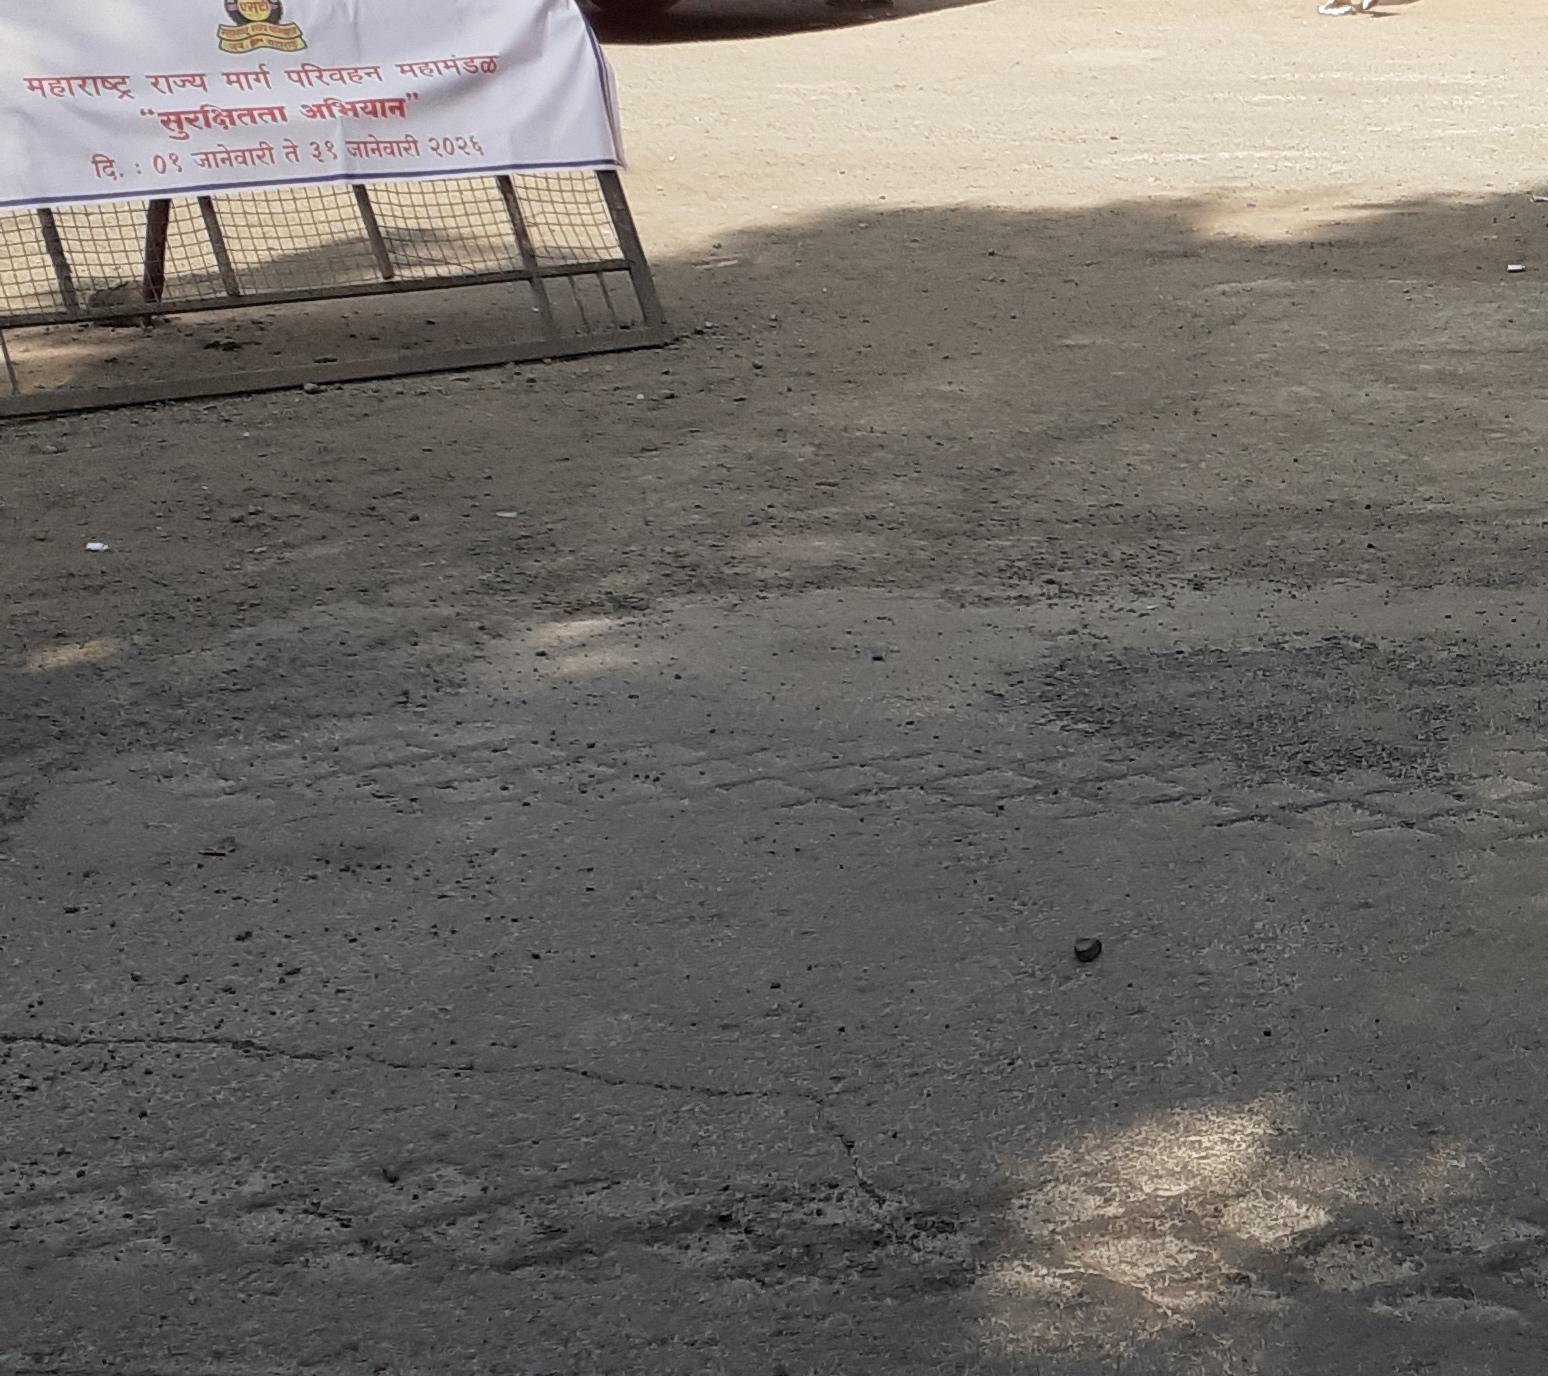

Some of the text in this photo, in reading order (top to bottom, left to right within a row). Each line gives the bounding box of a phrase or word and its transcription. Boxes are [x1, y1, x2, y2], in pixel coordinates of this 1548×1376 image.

[23, 54, 500, 100] महाराष्ट्र राज्य मार्ग परिवहन महामंडळ
[191, 141, 275, 170] जानेवारी
[282, 137, 300, 163] ते
[308, 140, 339, 163] ३१
[344, 133, 421, 159] जानेवारी
[427, 134, 485, 157] २०२६
